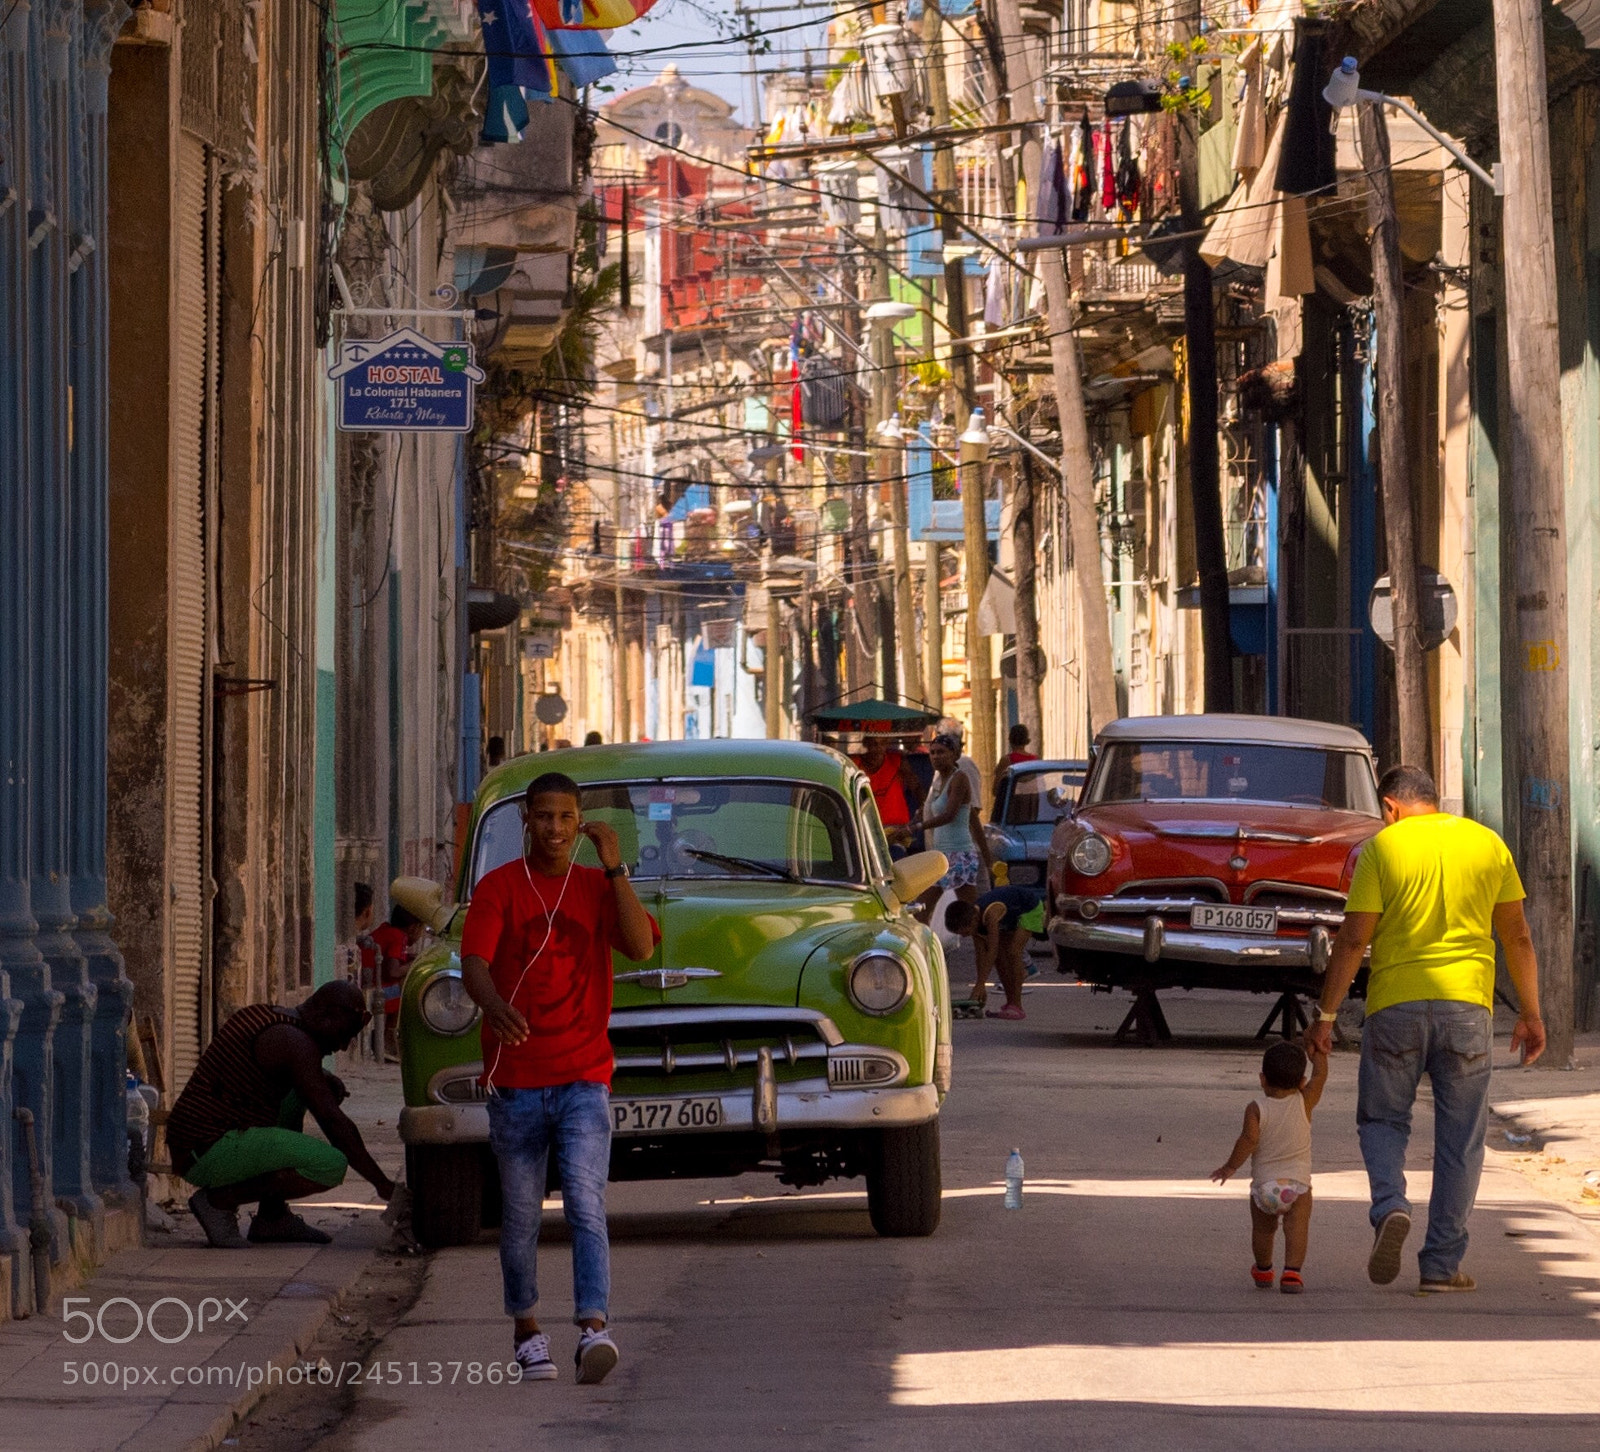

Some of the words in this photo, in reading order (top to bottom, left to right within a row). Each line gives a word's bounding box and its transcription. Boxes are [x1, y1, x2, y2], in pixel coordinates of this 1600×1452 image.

[367, 366, 444, 384] HOSTAL
[350, 387, 362, 397] La
[365, 387, 408, 397] Colonial
[410, 387, 462, 397] Habanera
[389, 398, 417, 408] 1715
[364, 406, 404, 419] Roberto
[405, 413, 413, 425] y
[415, 407, 446, 425] Mary
[1246, 911, 1273, 930] 057
[678, 1102, 718, 1126] 606
